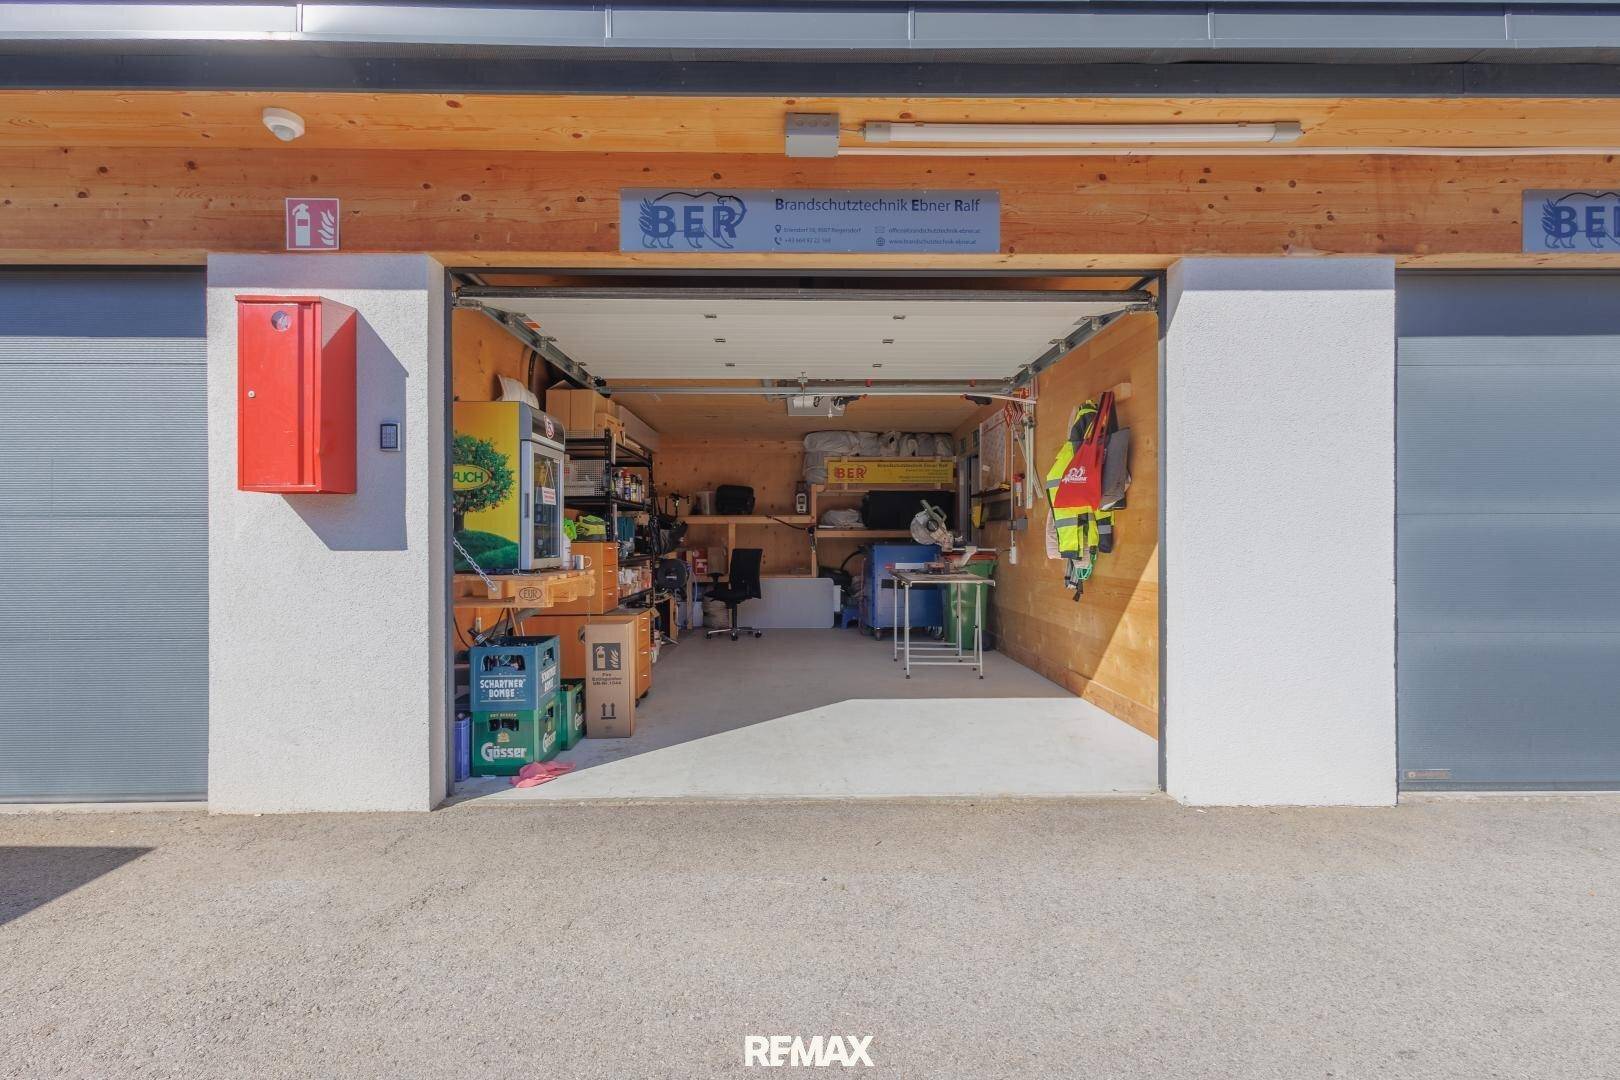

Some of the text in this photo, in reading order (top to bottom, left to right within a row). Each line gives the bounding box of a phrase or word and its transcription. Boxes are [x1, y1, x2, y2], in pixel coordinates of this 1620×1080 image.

[775, 198, 981, 212] Brandschutztechnik Ebner Ralf
[652, 204, 737, 238] BER
[453, 471, 484, 483] AUCH
[834, 467, 865, 479] BER
[523, 589, 538, 599] EUR
[480, 679, 524, 689] SCHARTNER
[489, 688, 515, 698] BOMBE
[480, 741, 528, 762] Gösser
